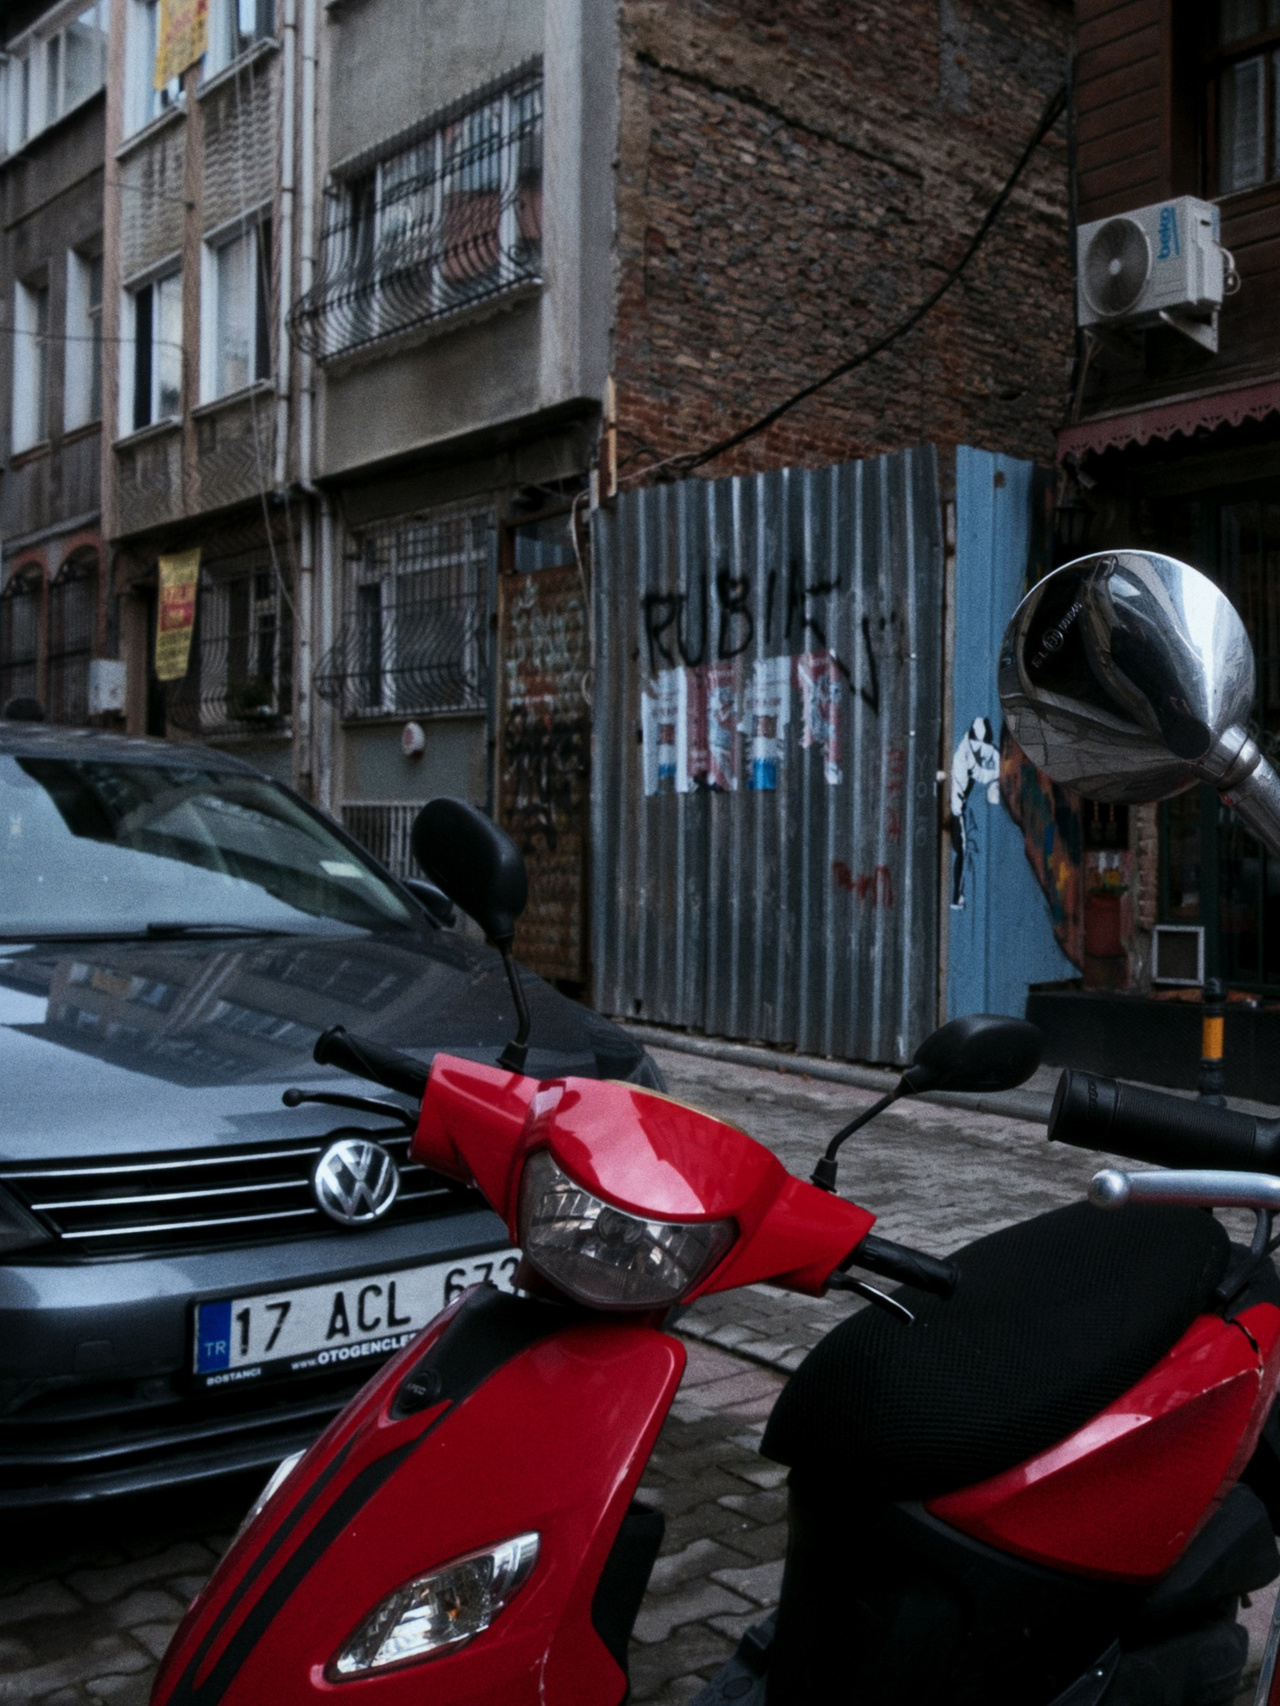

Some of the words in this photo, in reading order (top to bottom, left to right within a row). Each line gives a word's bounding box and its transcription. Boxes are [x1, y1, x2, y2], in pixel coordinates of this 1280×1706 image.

[1157, 206, 1171, 260] beko
[236, 1301, 291, 1356] 17
[326, 1281, 411, 1340] ACL
[204, 1340, 226, 1357] TR
